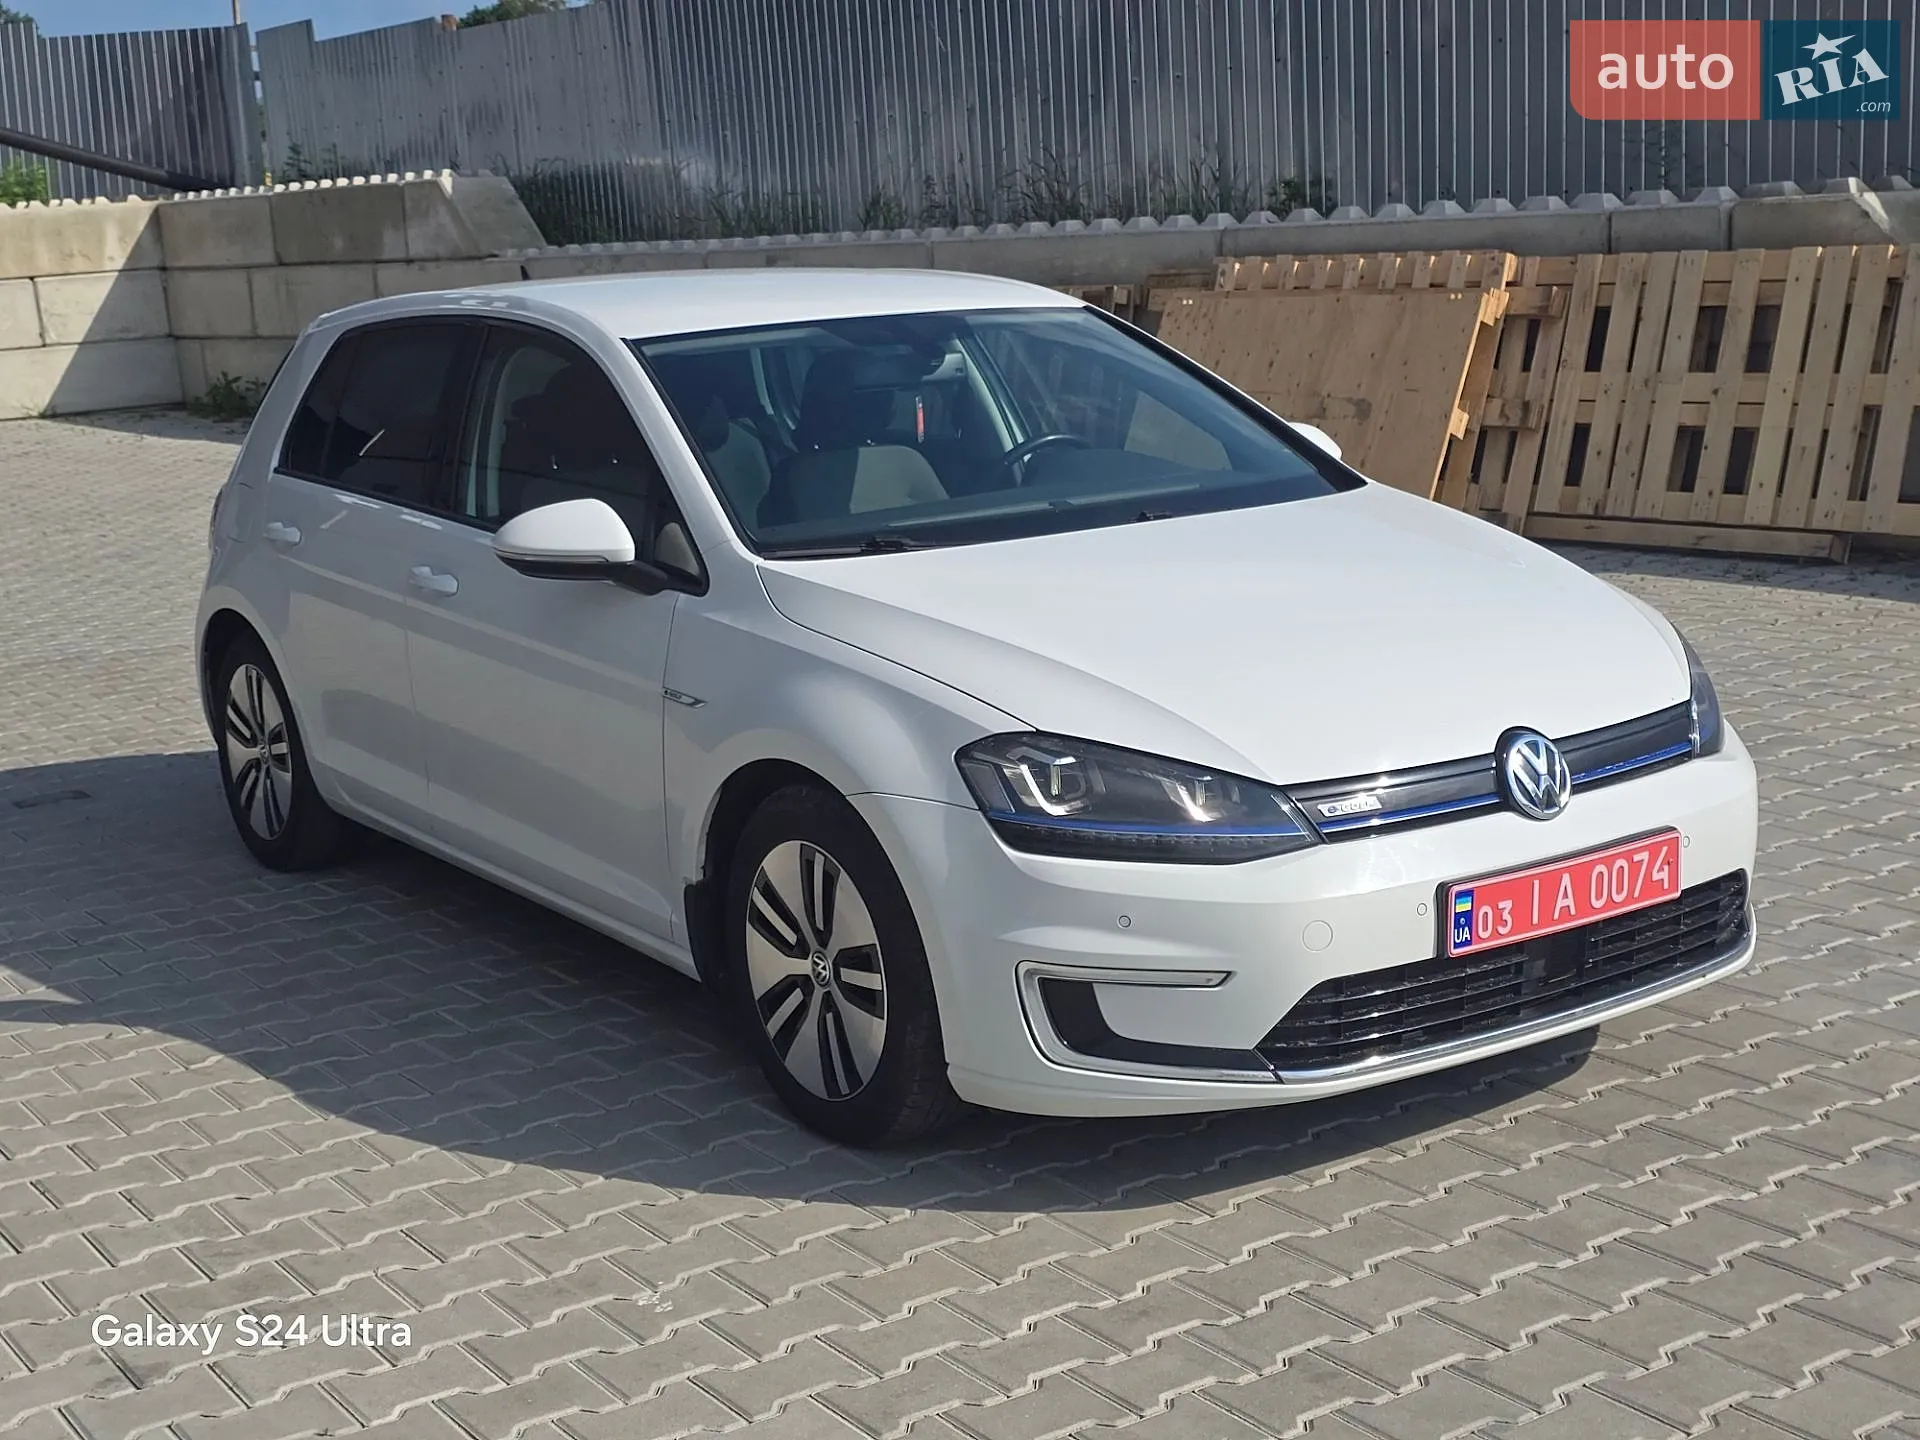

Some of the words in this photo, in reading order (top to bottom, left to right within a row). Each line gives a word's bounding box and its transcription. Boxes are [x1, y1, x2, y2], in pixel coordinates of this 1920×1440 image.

[1477, 900, 1513, 939] 03
[1590, 846, 1669, 909] 0074
[1454, 926, 1471, 943] UA
